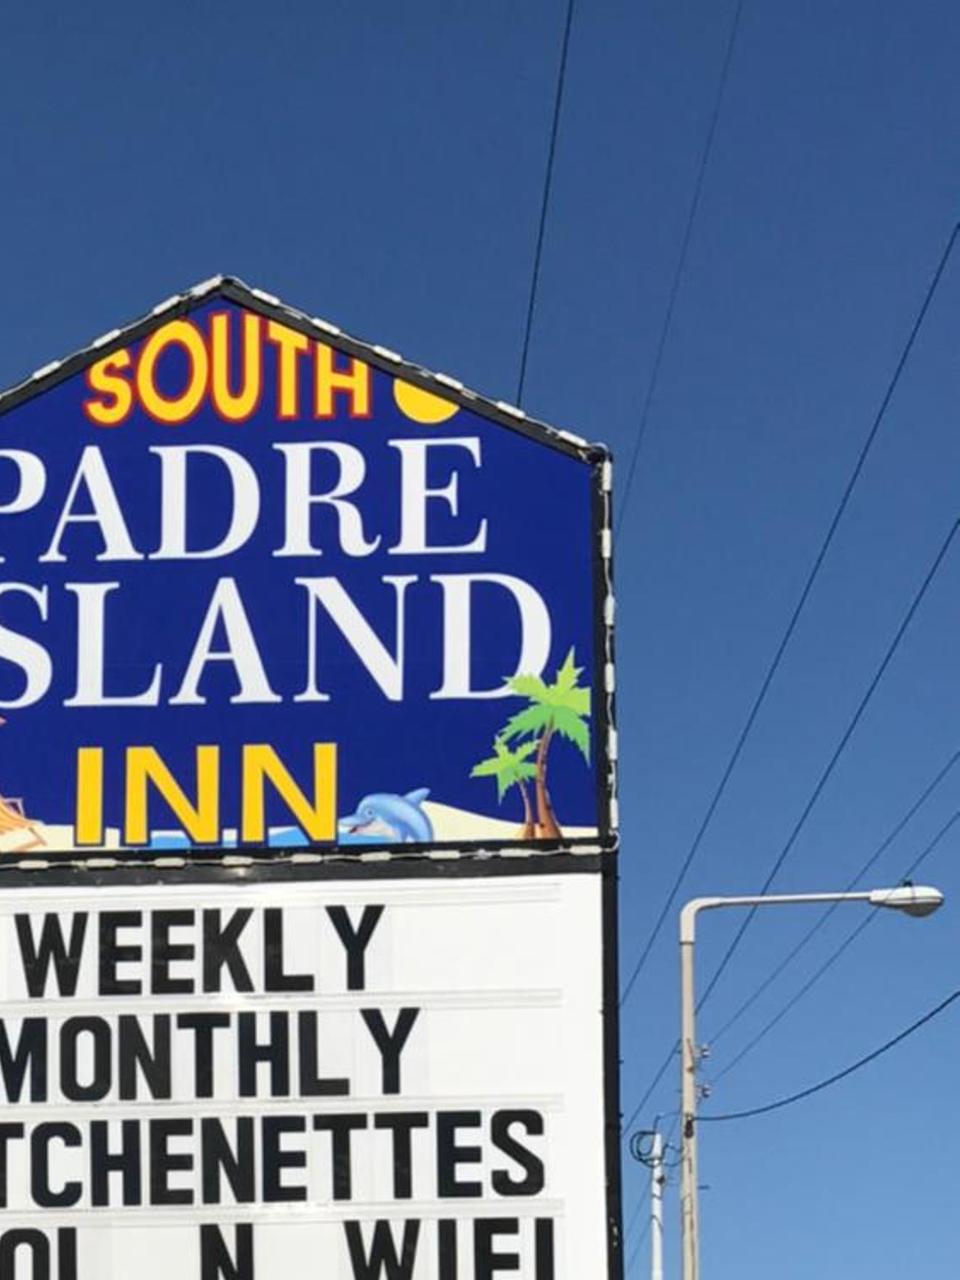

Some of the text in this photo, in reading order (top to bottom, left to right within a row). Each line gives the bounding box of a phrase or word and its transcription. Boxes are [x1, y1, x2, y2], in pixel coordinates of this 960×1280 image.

[84, 310, 372, 427] SOUTH
[74, 742, 338, 846] INN
[14, 904, 386, 998] WEEKLY
